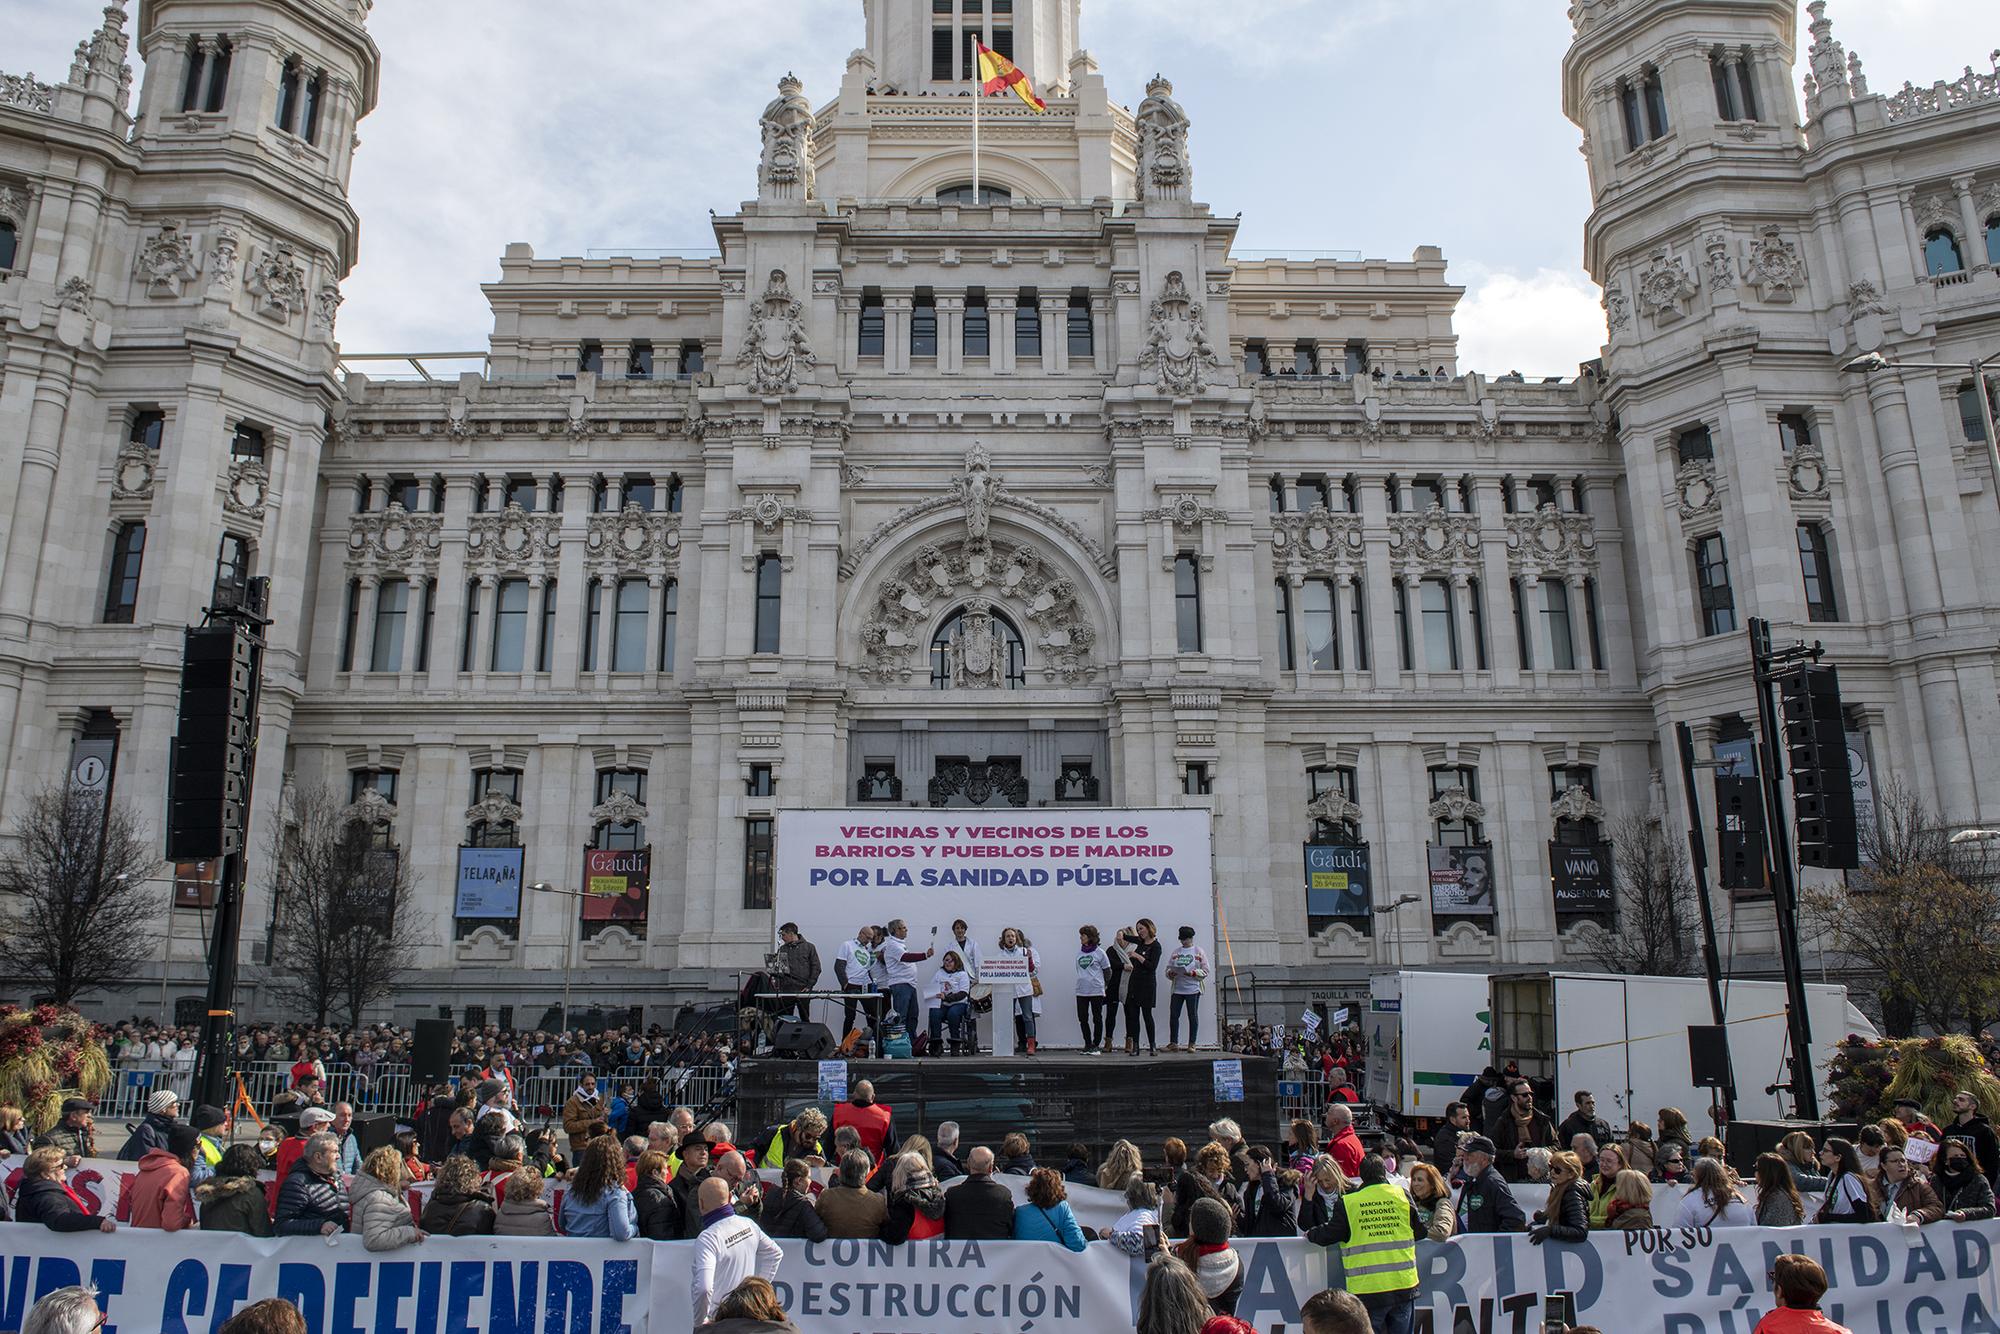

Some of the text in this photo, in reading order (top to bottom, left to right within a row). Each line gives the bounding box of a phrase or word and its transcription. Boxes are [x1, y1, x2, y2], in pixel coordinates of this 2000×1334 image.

[840, 826, 1149, 838] VECINAS Y VECINOS DE LOS
[815, 844, 1174, 857] BARRIOS Y PUEBLOS DE MADRID
[1310, 849, 1361, 868] Gaudí
[591, 853, 644, 872] Gaudí
[463, 865, 516, 884] TELARAÑA
[810, 864, 1180, 886] POR LA SANIDAD PÚBLICA
[1556, 888, 1612, 899] AUSENCIAS
[1312, 991, 1371, 999] TAQUILLA TIC
[1624, 1226, 1713, 1256] POR SU
[804, 1239, 987, 1268] CONTRA
[771, 1272, 1080, 1319] DESTRUCCIÓN
